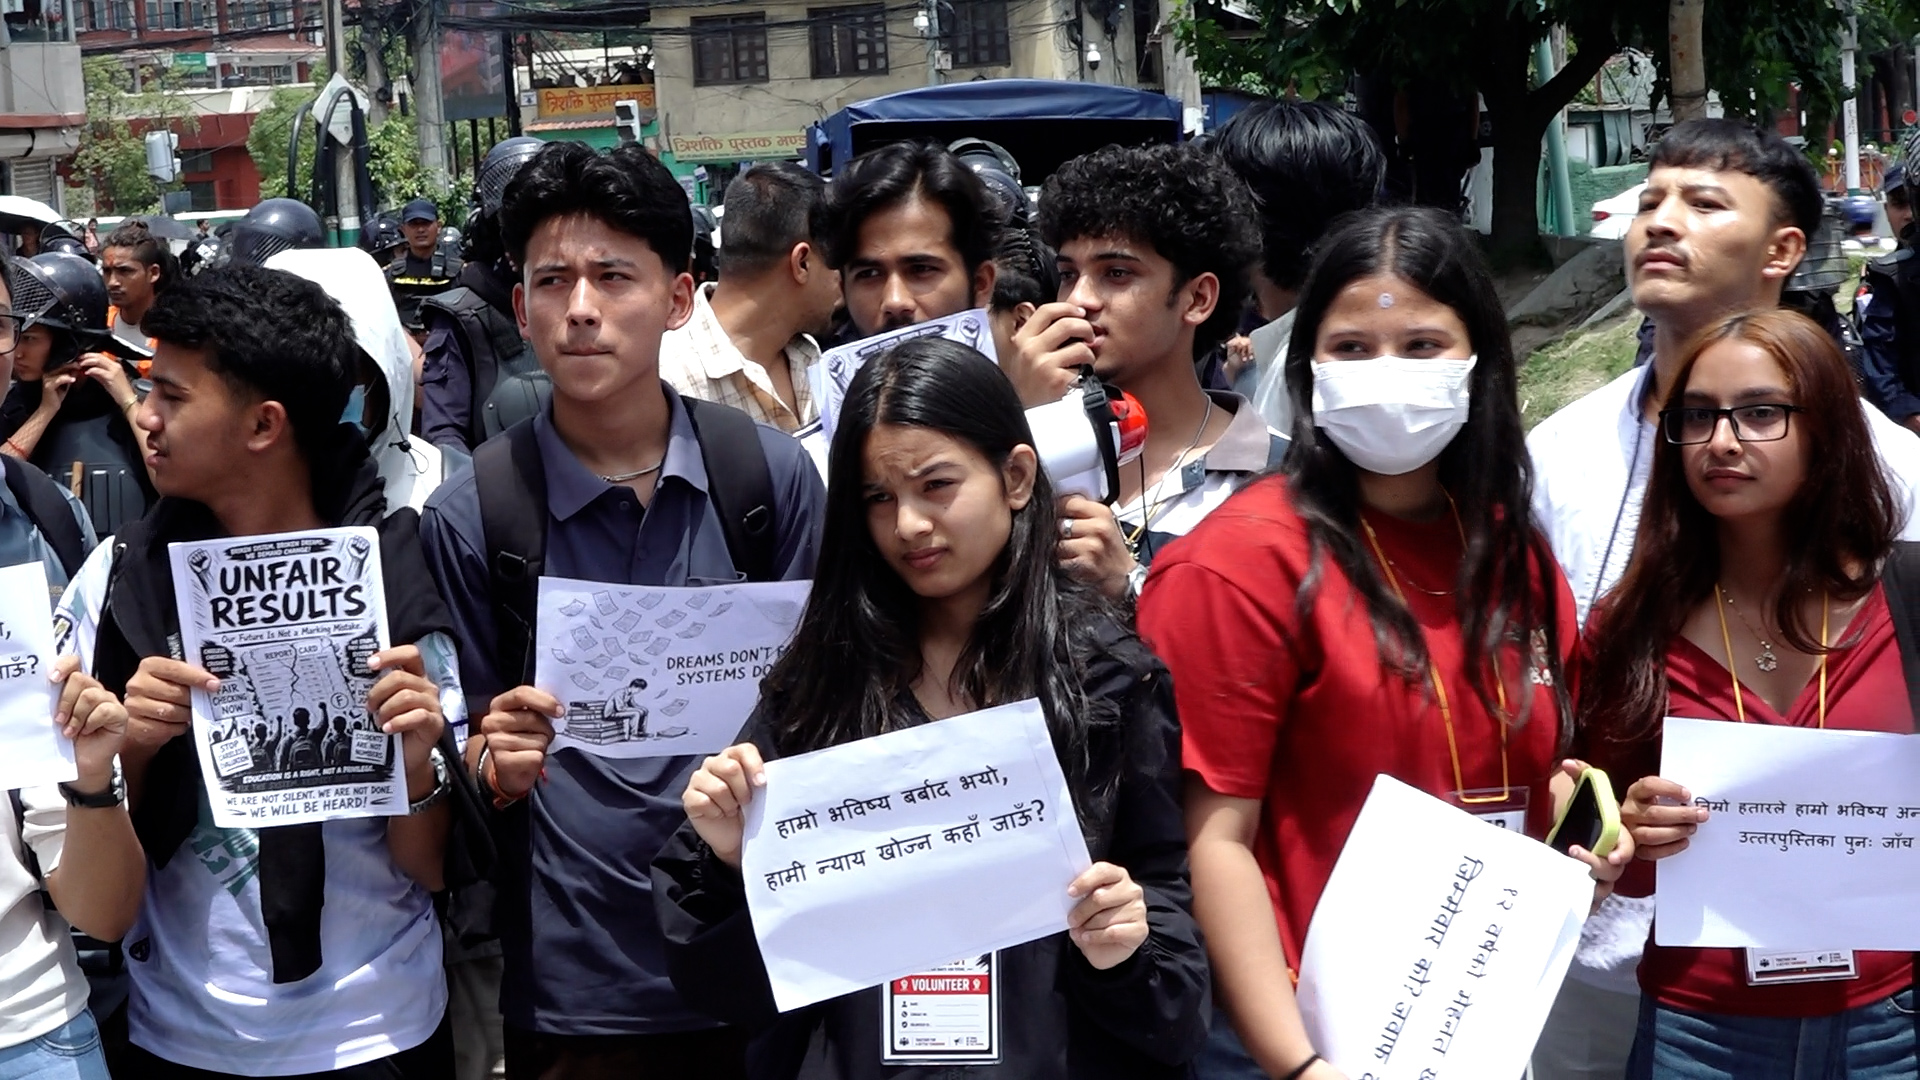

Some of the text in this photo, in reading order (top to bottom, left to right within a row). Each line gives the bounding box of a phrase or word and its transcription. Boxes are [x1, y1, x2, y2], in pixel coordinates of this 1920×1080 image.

[729, 135, 772, 152] पुस्तक
[257, 549, 282, 558] DEMAND
[220, 557, 346, 596] UNFAIR
[210, 584, 367, 628] RESULTS
[221, 634, 236, 643] Our
[240, 632, 263, 642] Future
[267, 630, 274, 638] Is
[278, 629, 291, 638] Not
[301, 626, 331, 635] Marking
[333, 622, 363, 631] Mistake.
[264, 645, 318, 660] REPORT CARD
[667, 653, 724, 670] DREAMS
[730, 646, 772, 664] DON'T
[0, 655, 39, 680] ाऊँ?
[676, 666, 746, 685] SYSTEMS
[213, 692, 247, 706] CHECKING
[222, 702, 243, 714] NOW
[336, 695, 343, 706] F
[220, 740, 239, 752] STOP
[355, 732, 384, 742] STUDENTS
[356, 741, 367, 749] ARE
[243, 773, 282, 784] EDUCATION
[284, 771, 291, 779] IS
[293, 771, 298, 779] A
[300, 768, 321, 777] RIGHT,
[323, 766, 336, 775] NOT
[336, 766, 342, 774] A
[226, 785, 393, 806] WE ARE NOT SILENT. WE ARE NOT DONE.
[775, 765, 1009, 839] हाम्रो भविष्य बर्बाद भयो,
[250, 797, 368, 818] WE WILL BE HEARD!
[1739, 800, 1787, 815] हतारले
[1795, 801, 1829, 817] हाम्रो
[1837, 802, 1888, 818] भविष्य
[765, 799, 1045, 892] हामी न्याय खोज्न कहाँ जाऊँ?
[1738, 829, 1836, 852] उत्तरपुस्तिका
[1882, 832, 1915, 849] जाँच
[1374, 855, 1484, 1065] जिम्मेवार को? जवाफ
[1466, 923, 1504, 979] वर्षको
[911, 978, 970, 991] VOLUNTEER
[1432, 989, 1473, 1057] मेहनत
